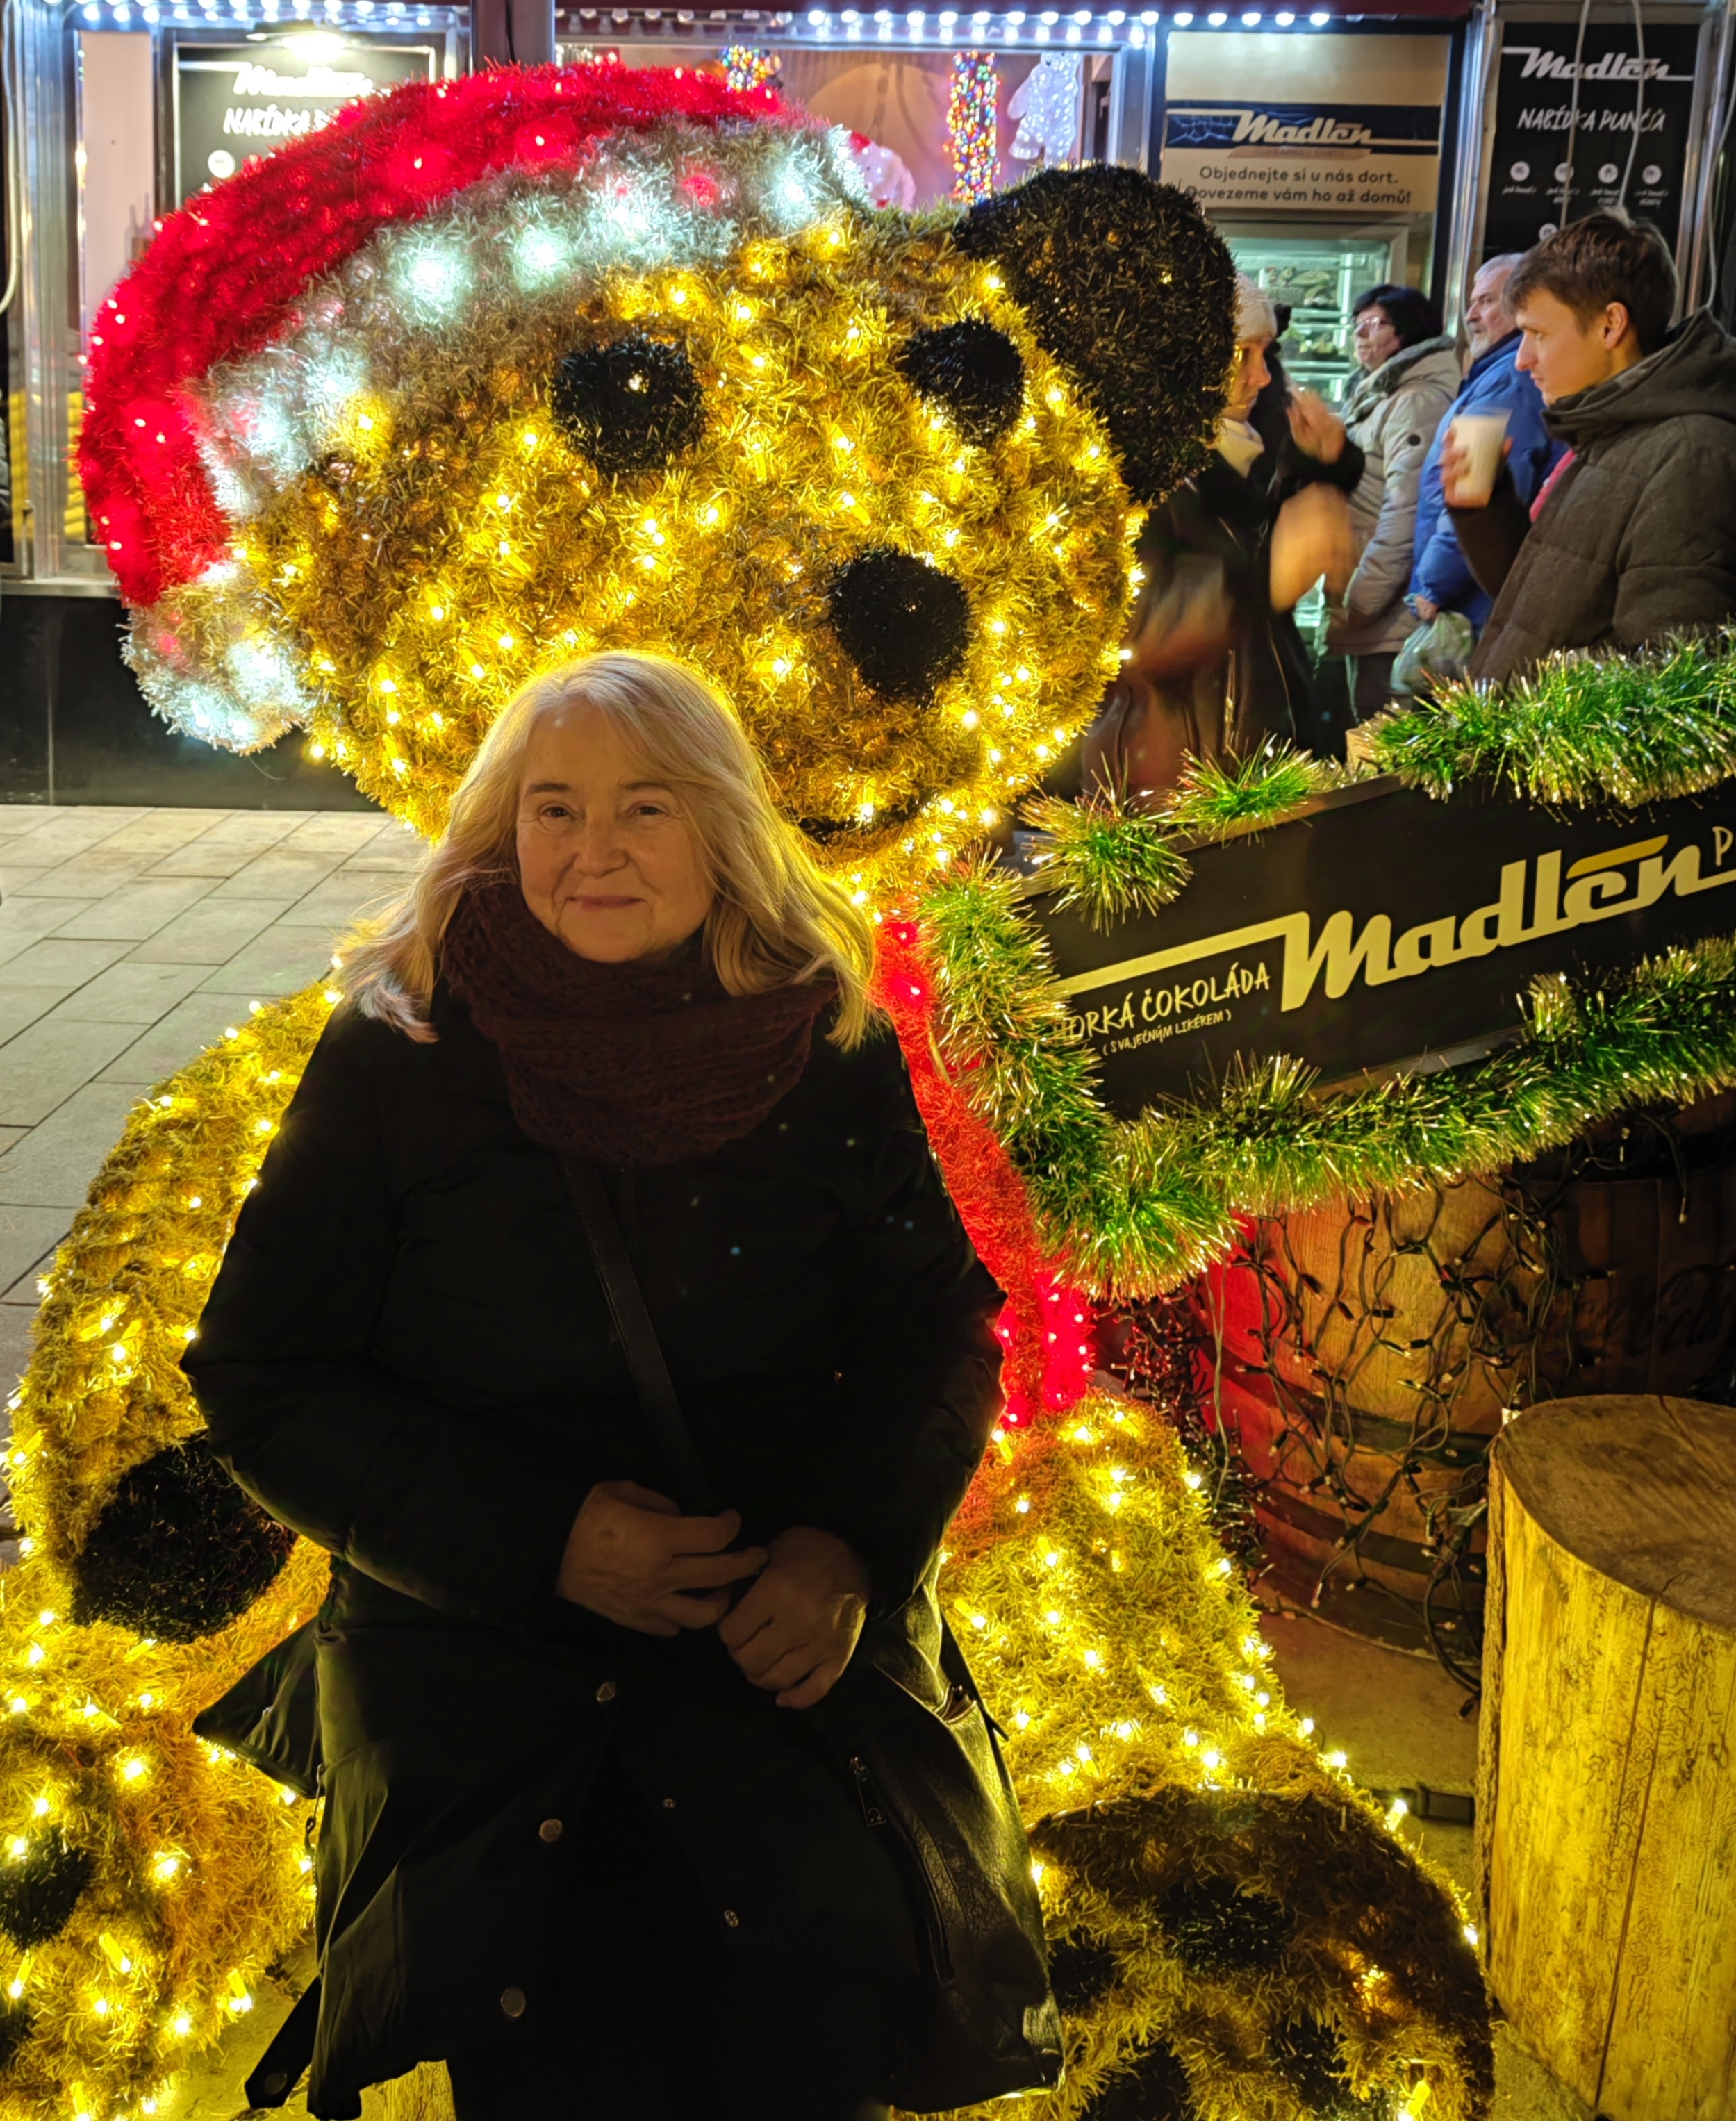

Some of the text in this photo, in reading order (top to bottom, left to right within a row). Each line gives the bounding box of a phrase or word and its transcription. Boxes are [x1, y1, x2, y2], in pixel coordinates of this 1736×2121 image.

[1200, 166, 1287, 183] Objednejte
[1311, 172, 1320, 181] u
[1325, 169, 1353, 183] nás
[1358, 170, 1398, 183] dort.
[1273, 188, 1307, 201] vám
[1313, 188, 1332, 201] ho
[1336, 189, 1355, 202] až
[1359, 189, 1411, 204] domů!
[1141, 962, 1271, 1021] ČOKOLÁDA
